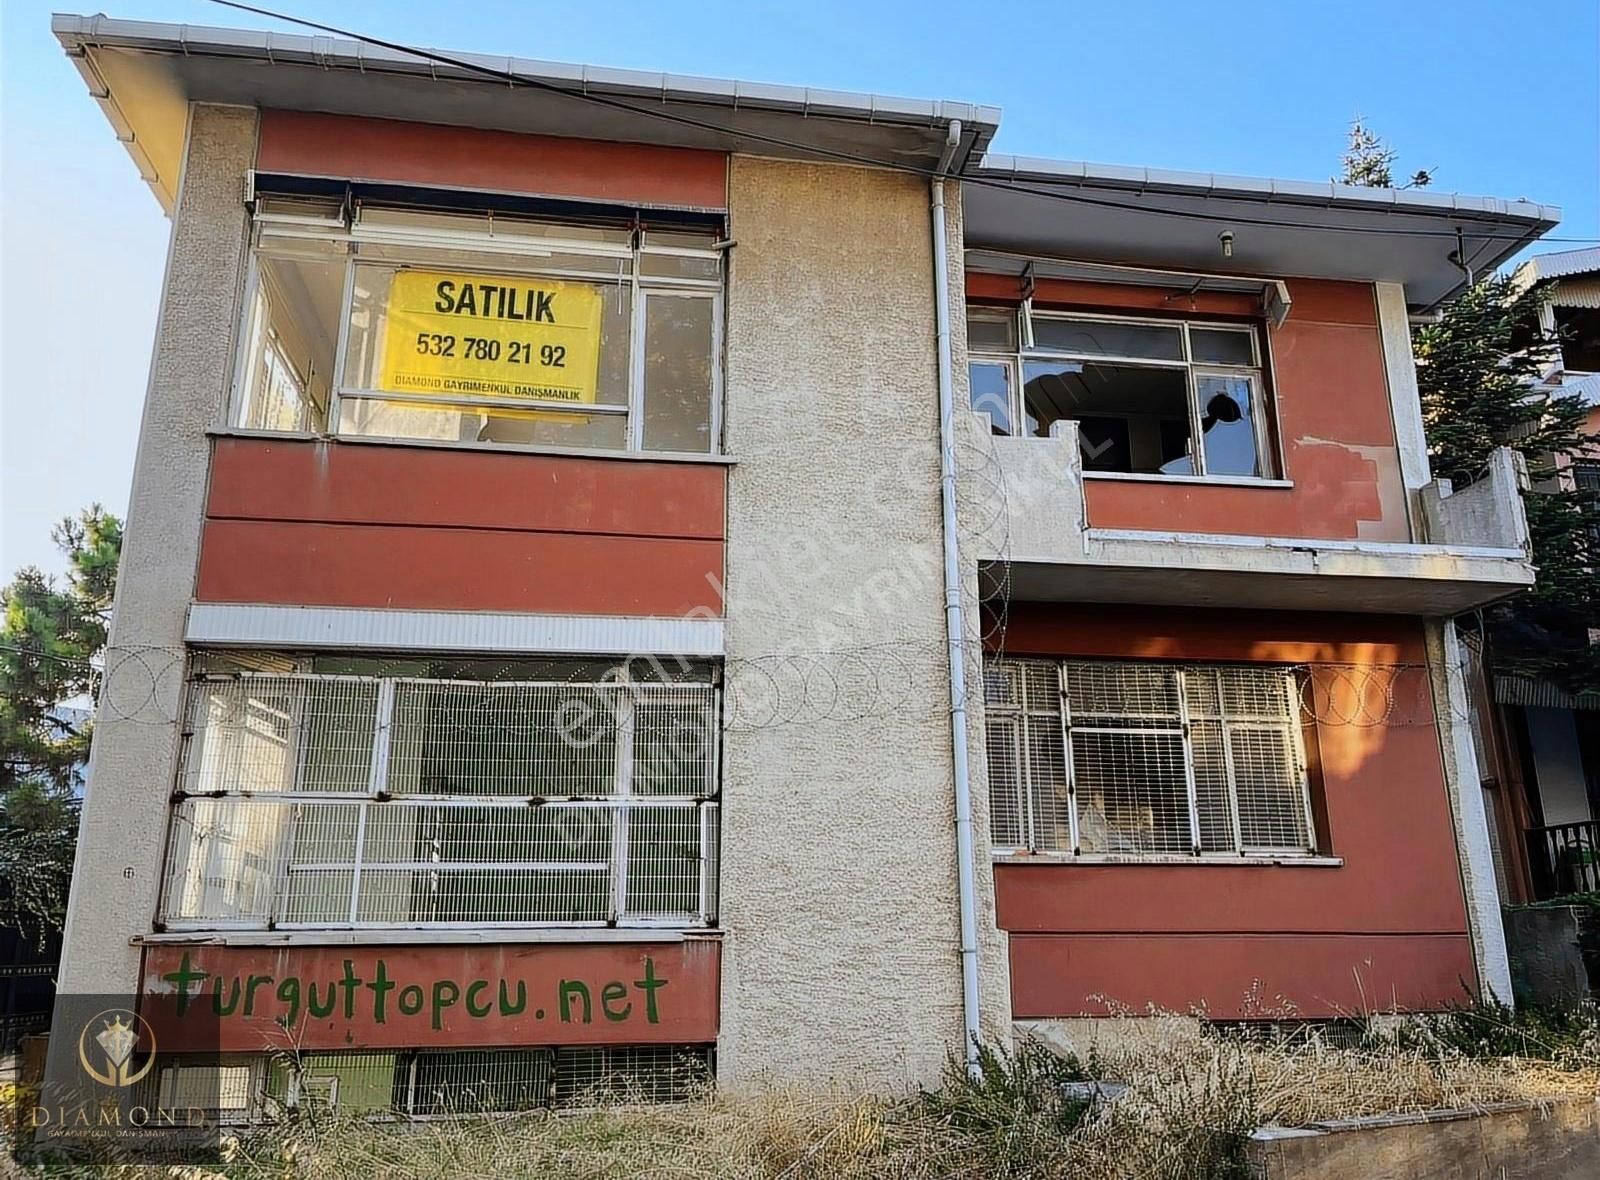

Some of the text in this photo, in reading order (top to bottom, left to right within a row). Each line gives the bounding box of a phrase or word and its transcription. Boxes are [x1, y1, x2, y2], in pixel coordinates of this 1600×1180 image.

[435, 281, 557, 323] SATILIK
[417, 333, 566, 367] 532 780 21 92
[395, 375, 441, 388] DIAMOND
[162, 952, 668, 1030] turguttopcu.net
